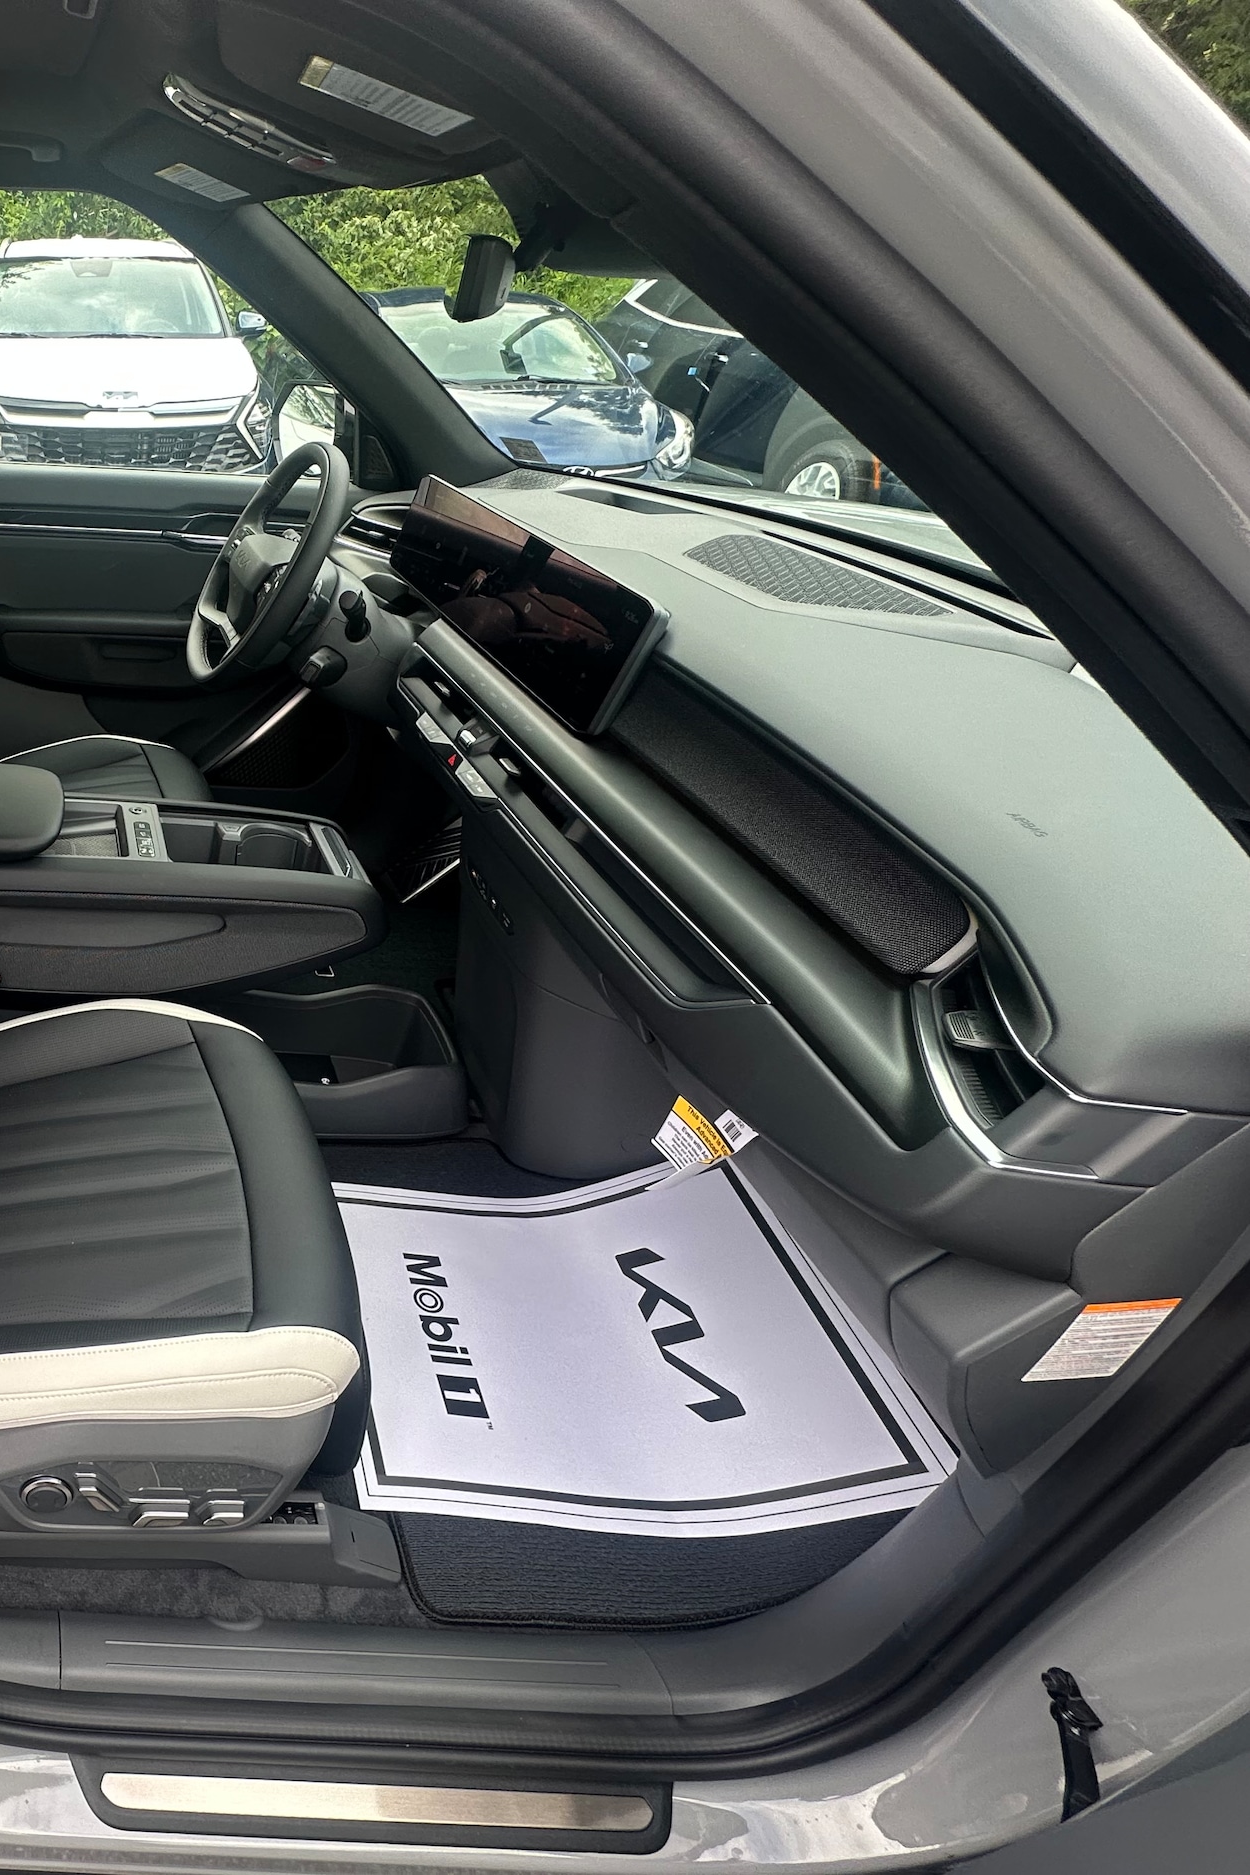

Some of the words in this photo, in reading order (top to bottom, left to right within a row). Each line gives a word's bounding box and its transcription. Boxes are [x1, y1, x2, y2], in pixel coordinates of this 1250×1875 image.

[681, 1126, 694, 1140] Even
[692, 1140, 703, 1151] with
[686, 1105, 700, 1120] This
[699, 1118, 718, 1140] Vehicle
[695, 1127, 719, 1154] Advanced
[402, 1252, 473, 1367] Mobil
[615, 1247, 746, 1423] KIA
